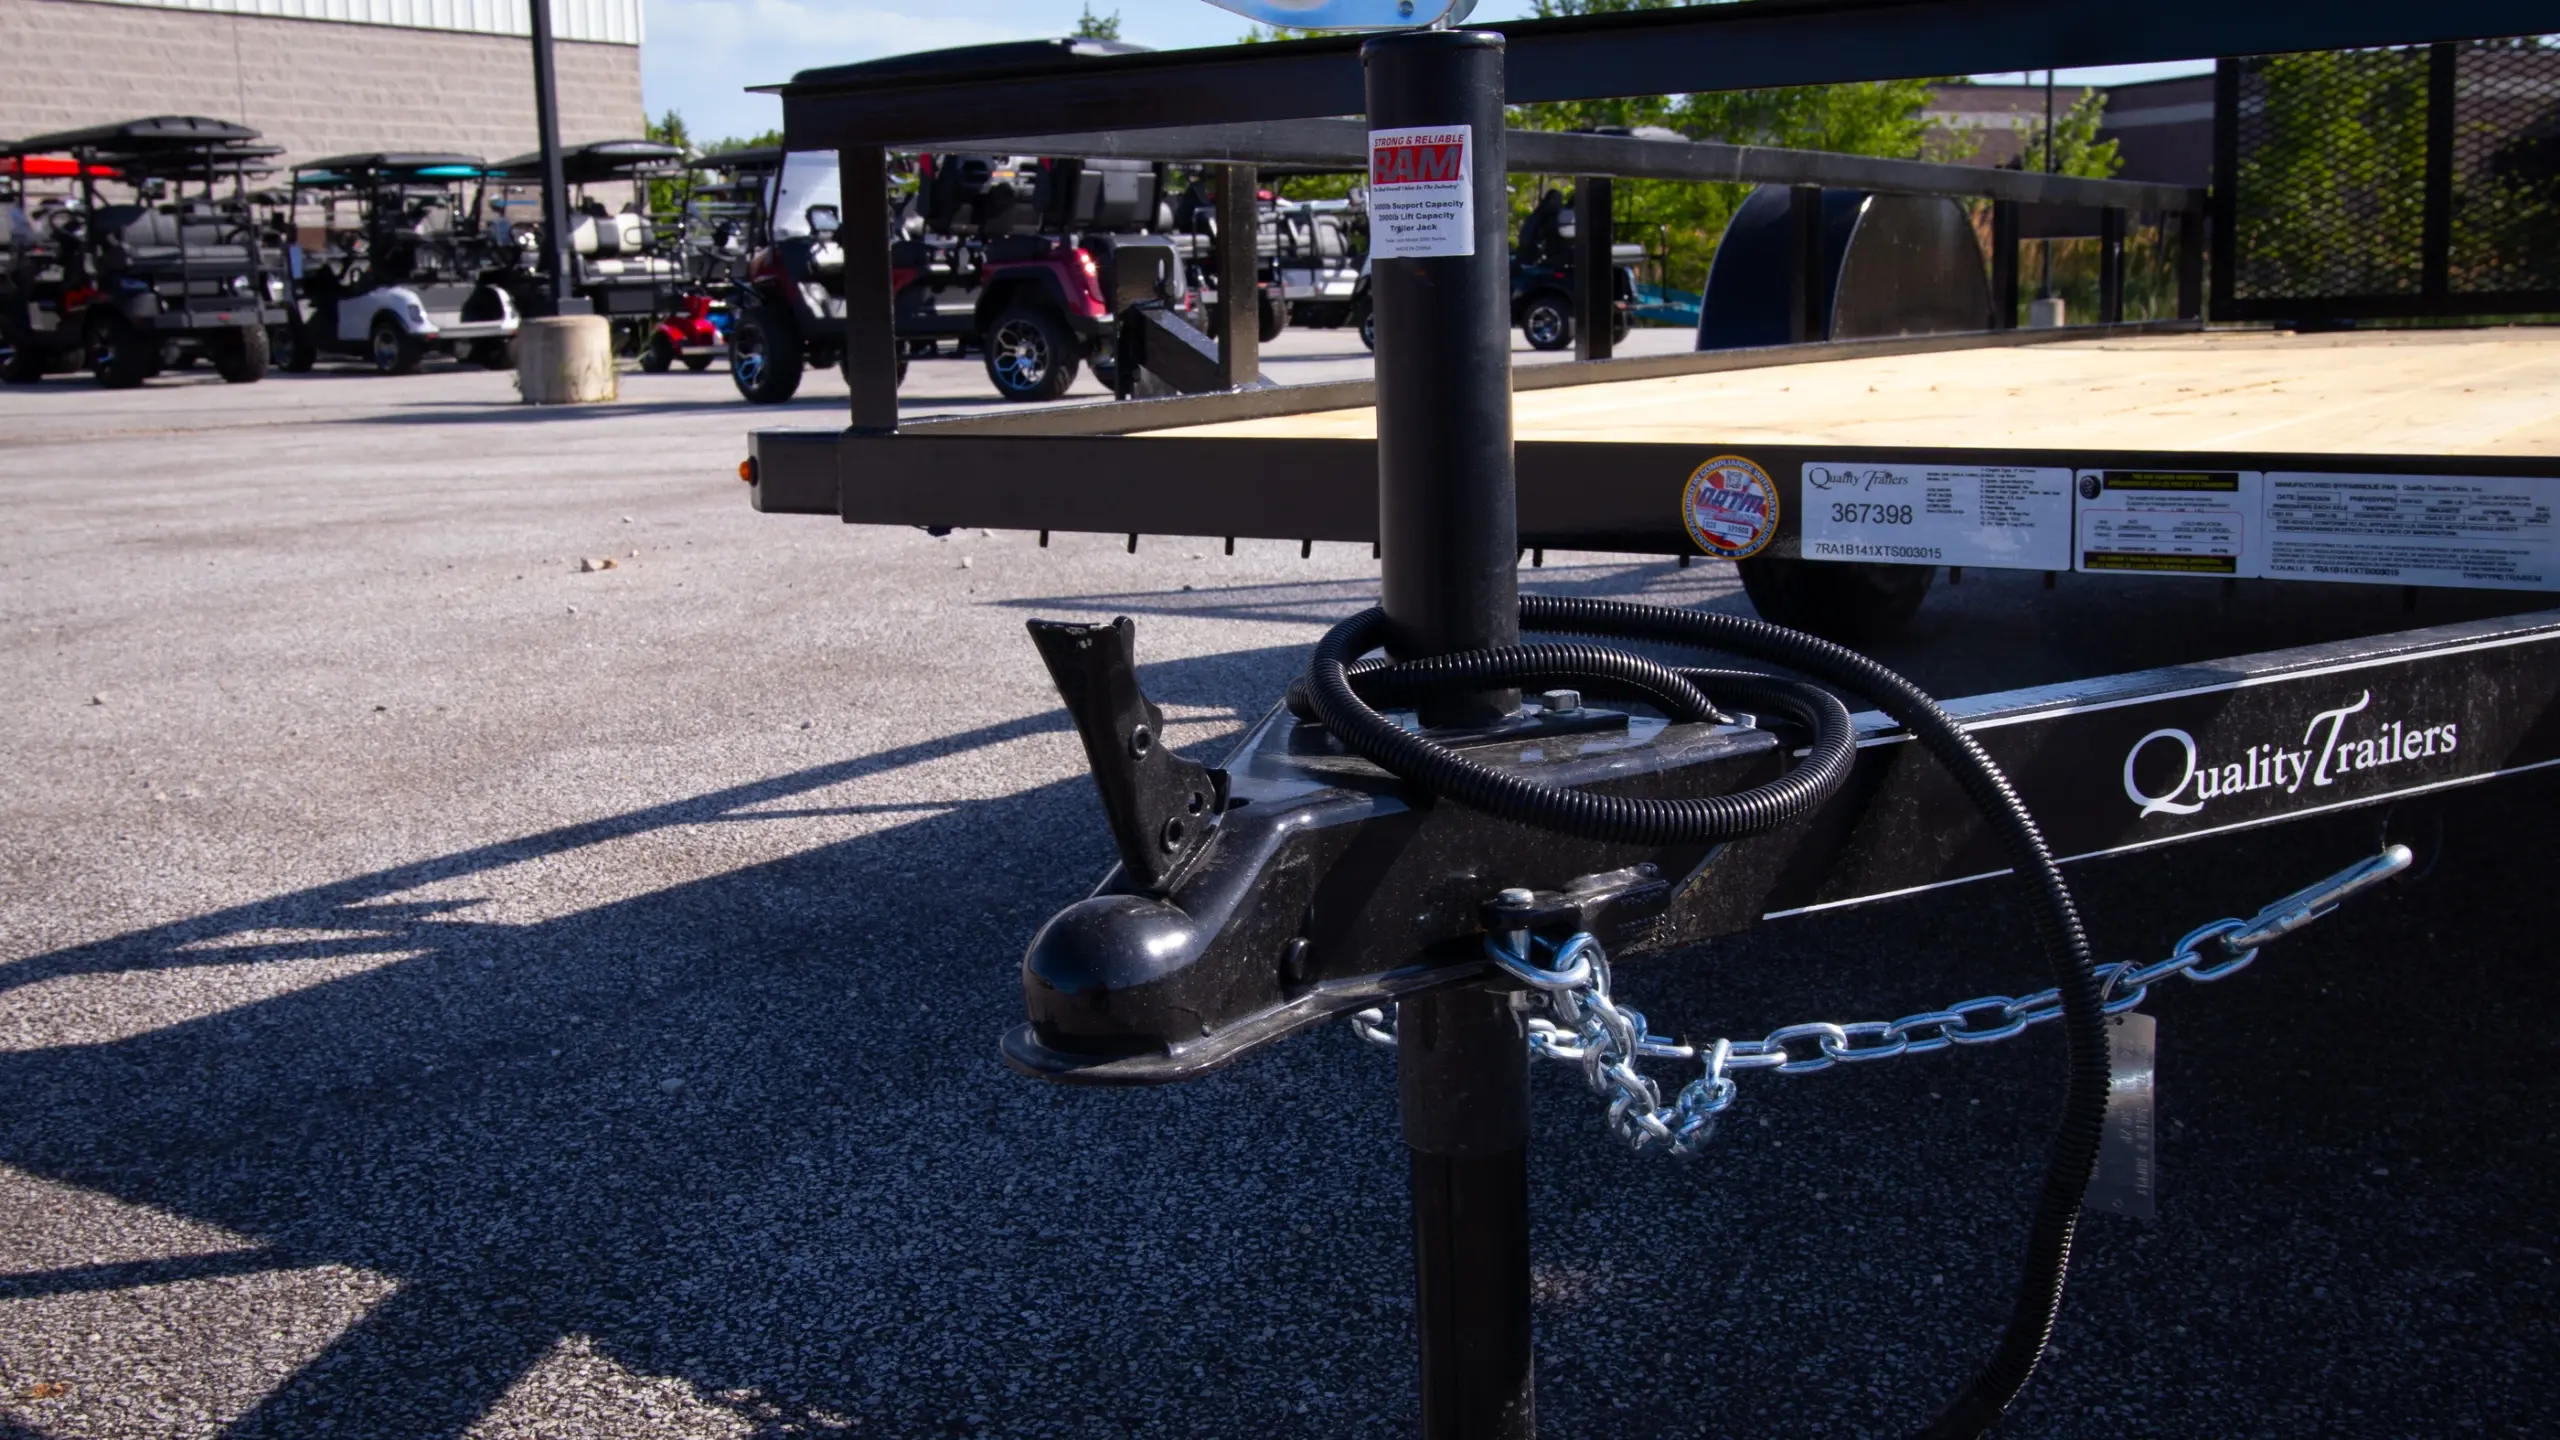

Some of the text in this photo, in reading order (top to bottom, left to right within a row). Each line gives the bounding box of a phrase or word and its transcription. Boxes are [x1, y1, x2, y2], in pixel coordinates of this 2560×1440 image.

[1374, 133, 1464, 147] STRONG & RELIABLE
[1374, 147, 1460, 182] RAM
[1392, 202, 1423, 210] Support
[1425, 200, 1464, 208] Capacity
[1401, 212, 1414, 220] Lift
[1415, 211, 1455, 221] Capacity
[1416, 223, 1438, 231] Jack
[1700, 459, 1754, 478] COMPLIANCE
[1754, 470, 1772, 491] WITH
[1768, 492, 1776, 521] NATM
[1831, 502, 1913, 525] 367398
[1815, 543, 1942, 559] 7RA1B141XTS003015
[2123, 688, 2458, 819] Quality Trailers
